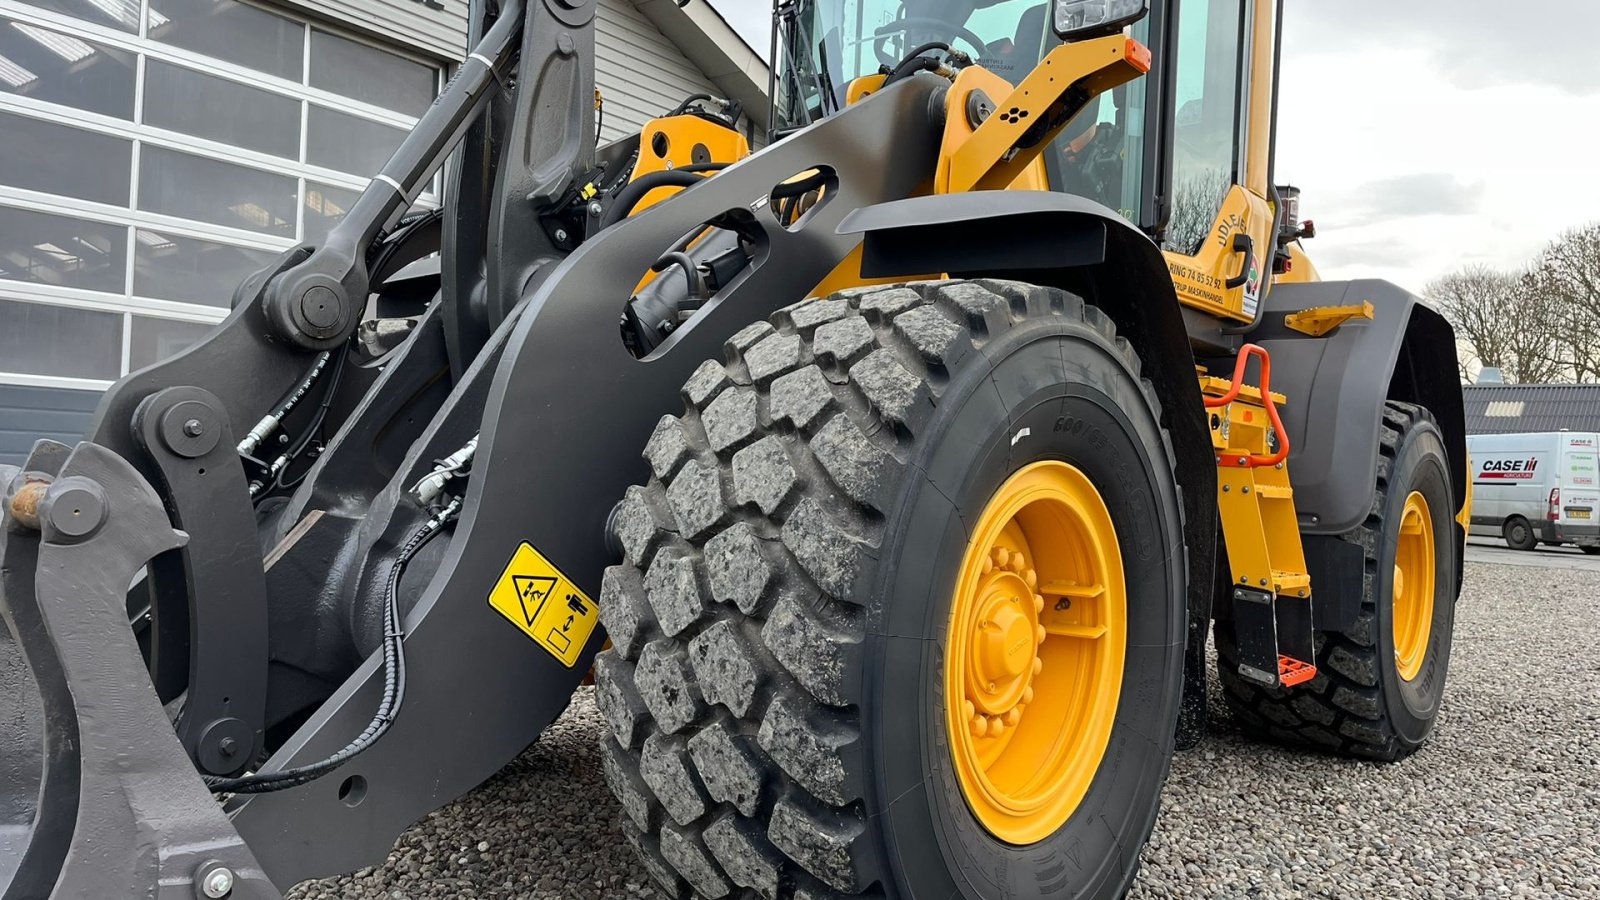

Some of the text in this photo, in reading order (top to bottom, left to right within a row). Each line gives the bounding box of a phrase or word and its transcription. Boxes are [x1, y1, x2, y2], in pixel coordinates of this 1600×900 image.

[1170, 263, 1221, 290] RING 74 85 52 92
[1187, 285, 1224, 304] MASKINHANDEL
[1482, 460, 1523, 471] CASE
